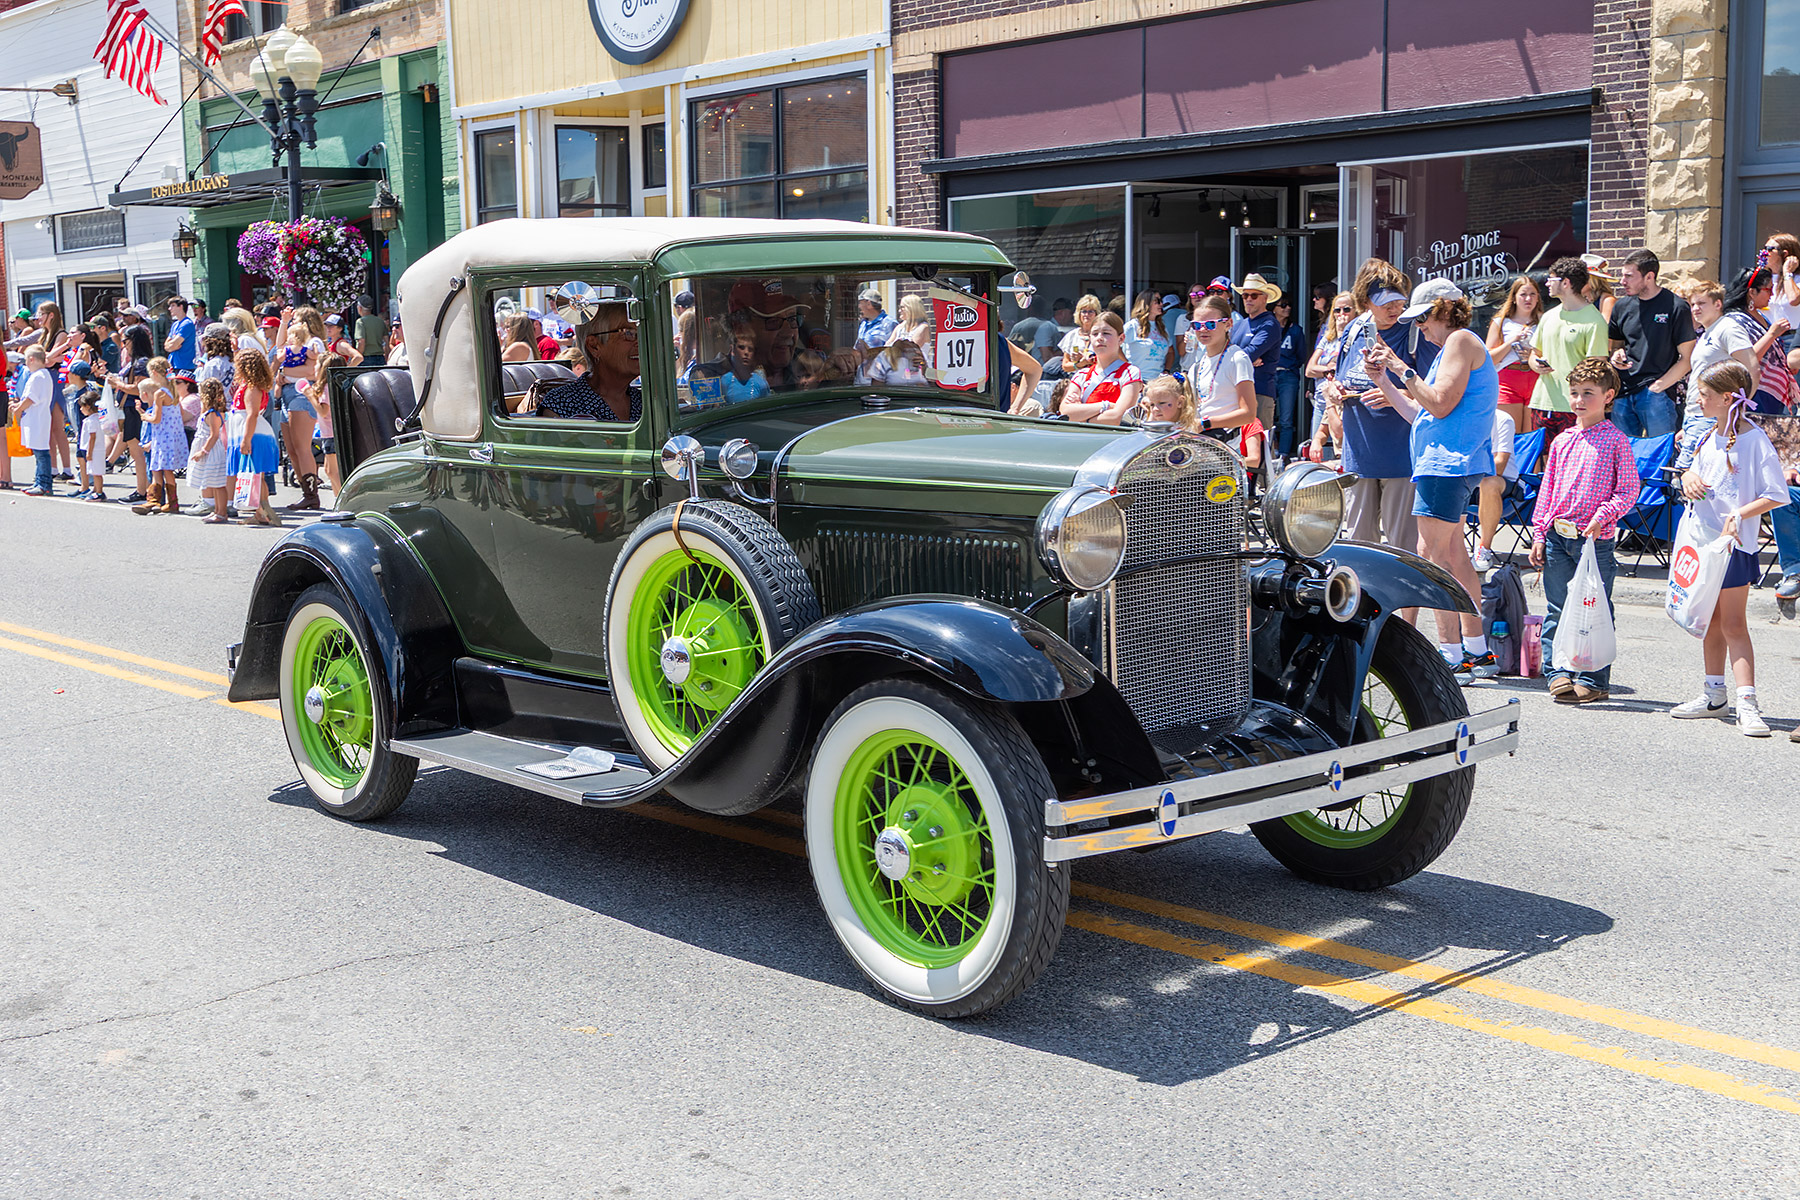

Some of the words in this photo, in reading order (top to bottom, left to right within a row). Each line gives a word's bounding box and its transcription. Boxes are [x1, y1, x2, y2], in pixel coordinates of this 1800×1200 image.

[613, 22, 638, 40] KITCHEN
[647, 13, 665, 35] HOME
[151, 182, 184, 199] FOSTER
[184, 181, 192, 193] &
[1430, 240, 1460, 269] RED
[1460, 230, 1501, 259] LODGE
[944, 304, 976, 330] Justin
[946, 338, 975, 368] 197
[1280, 335, 1292, 349] A
[1674, 550, 1699, 584] IGA
